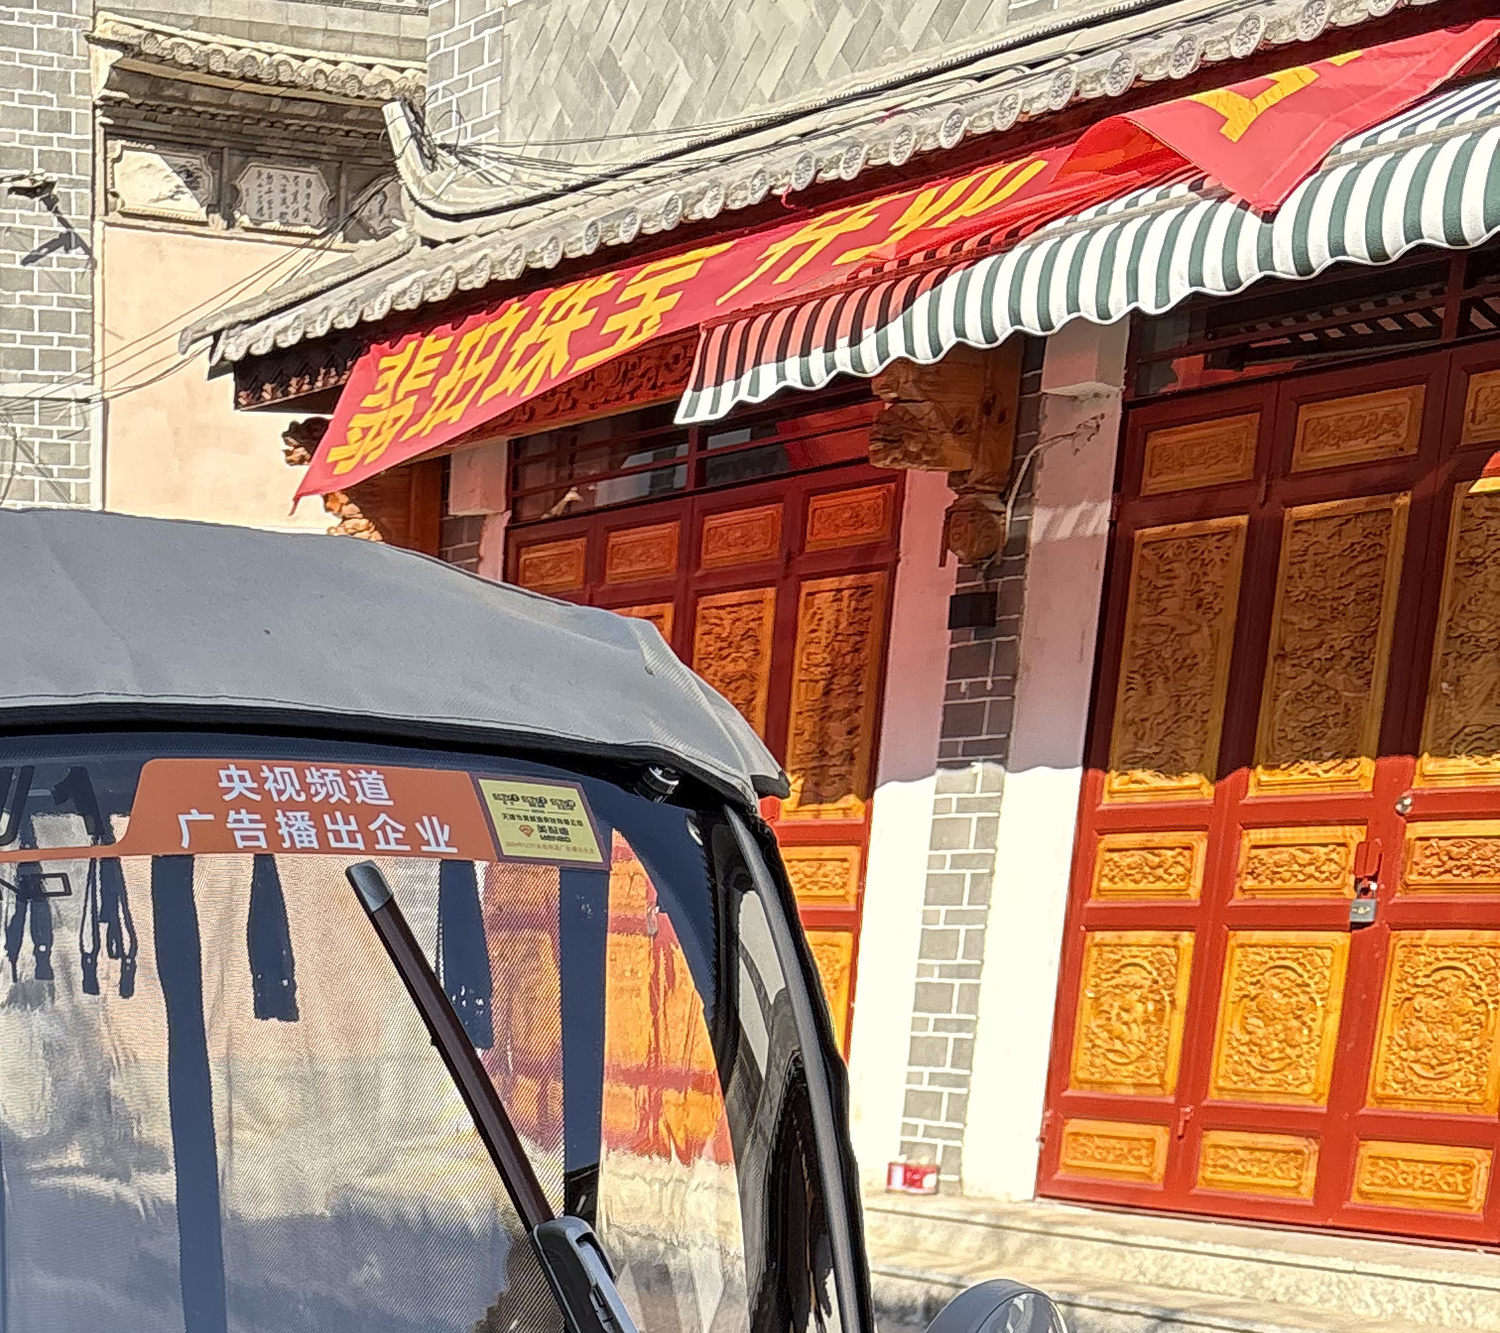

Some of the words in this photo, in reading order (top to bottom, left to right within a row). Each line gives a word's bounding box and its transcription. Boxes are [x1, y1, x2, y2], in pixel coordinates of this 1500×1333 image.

[715, 158, 1049, 306] 开业
[217, 763, 395, 807] 央视频道
[176, 808, 460, 854] 广告播出企业
